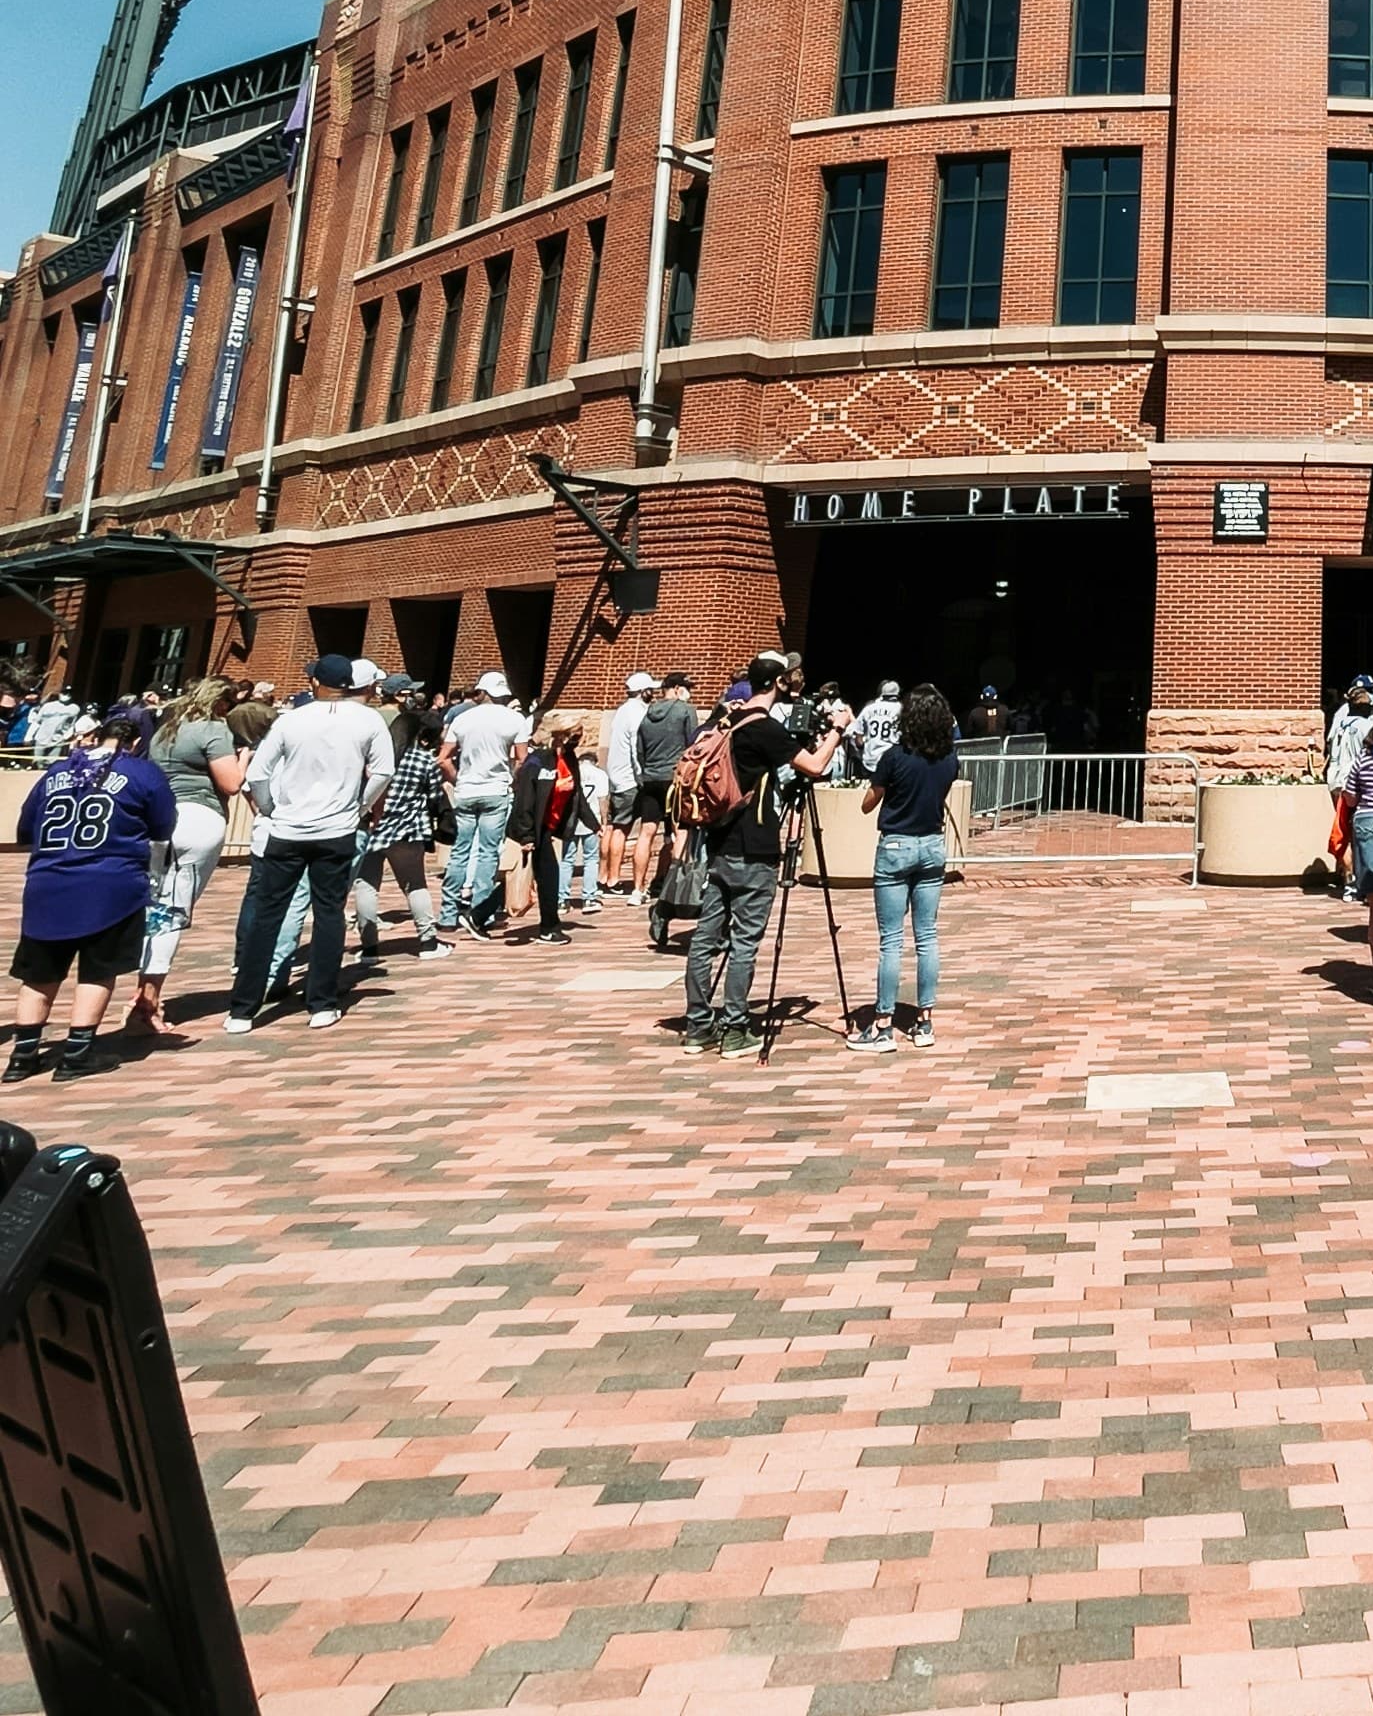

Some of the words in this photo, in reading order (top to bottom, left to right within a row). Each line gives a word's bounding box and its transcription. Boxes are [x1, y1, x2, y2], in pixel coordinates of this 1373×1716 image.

[243, 257, 257, 278] 2010
[227, 287, 252, 348] GONZALEZ
[71, 363, 93, 402] WALKER
[793, 490, 916, 522] HOME
[968, 484, 1121, 516] PLATE
[869, 720, 892, 738] 38
[39, 794, 115, 851] 28
